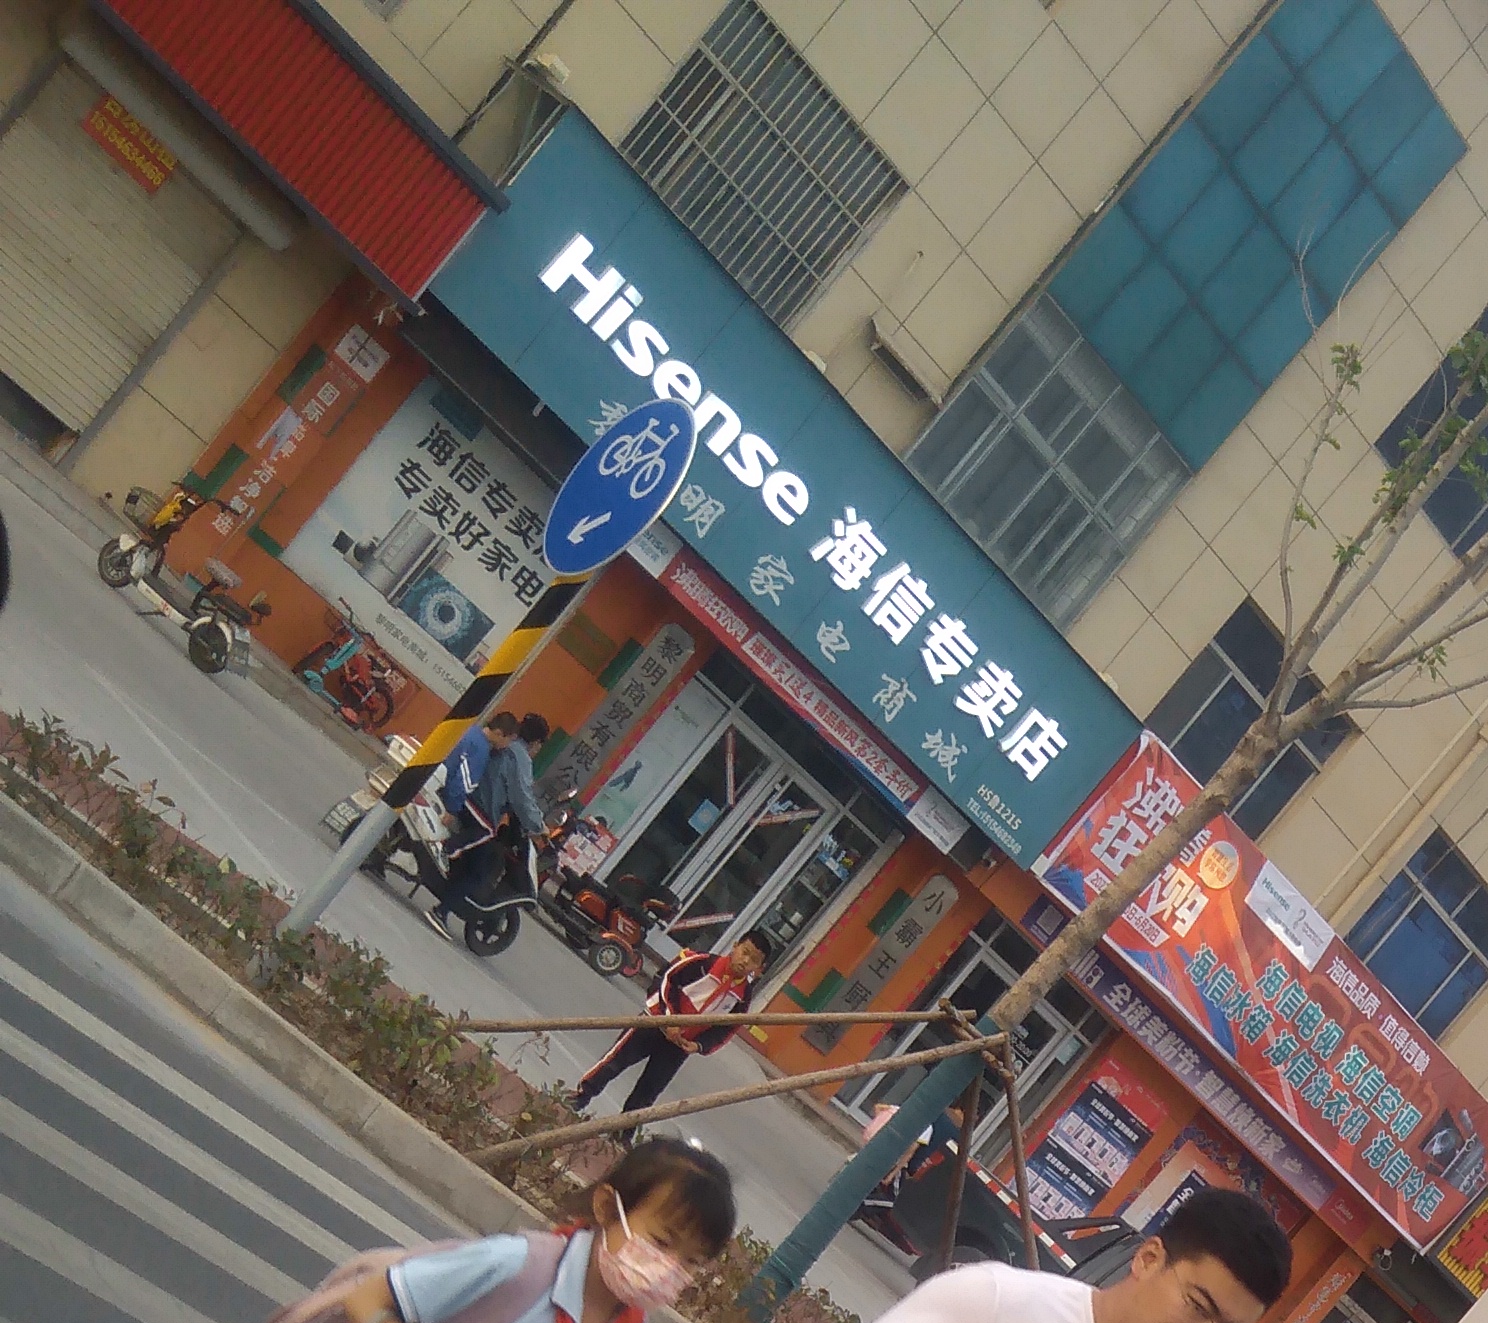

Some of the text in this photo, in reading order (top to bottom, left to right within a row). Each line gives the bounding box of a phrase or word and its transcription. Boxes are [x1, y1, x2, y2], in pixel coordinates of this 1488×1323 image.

[388, 456, 548, 608] 专卖好家电
[537, 233, 1069, 782] Hisense 海信专卖店
[1260, 877, 1292, 911] Hisense
[1179, 943, 1445, 1223] 海信冰箱 海信洗衣机 海信冷柜
[1251, 958, 1425, 1143] 海信电视 海信空调
